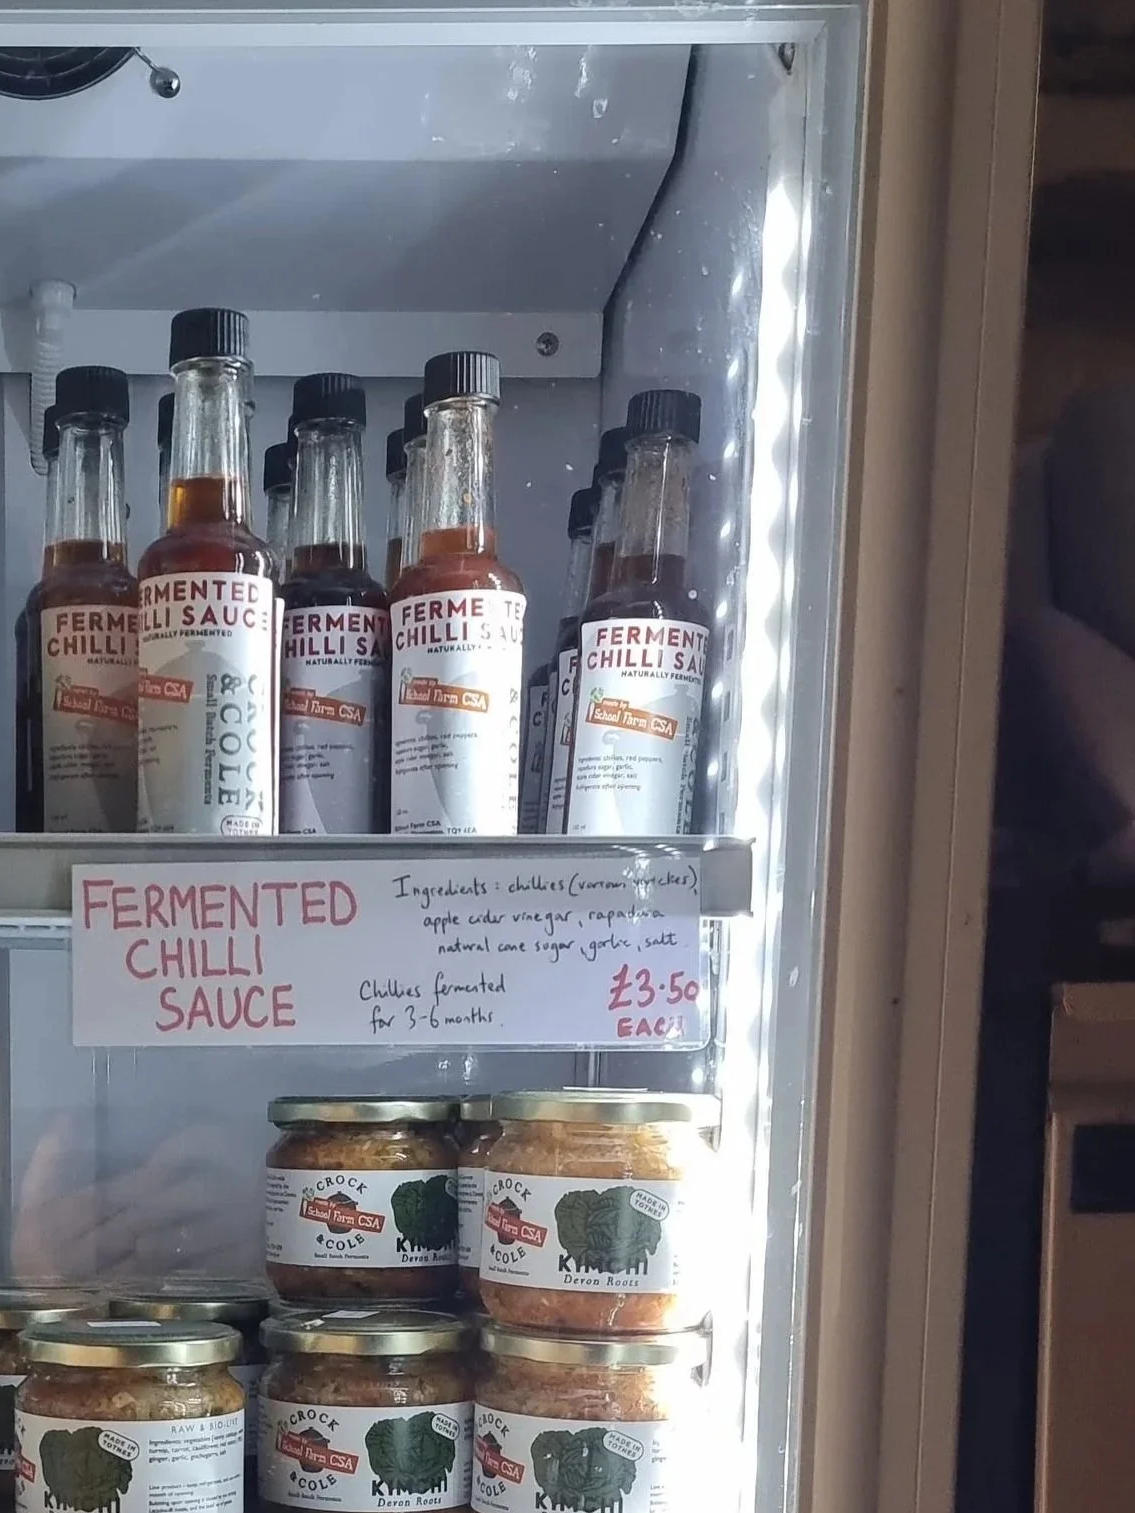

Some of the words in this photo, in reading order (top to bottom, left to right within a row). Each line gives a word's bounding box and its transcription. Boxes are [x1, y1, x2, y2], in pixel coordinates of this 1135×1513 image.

[396, 622, 467, 651] CHILLI
[587, 649, 663, 670] CHILLI
[621, 670, 669, 680] NATURALLY
[462, 693, 487, 711] CSA
[594, 710, 619, 722] School
[623, 712, 647, 728] Farm
[650, 715, 673, 736] CSA
[218, 703, 242, 805] COLE
[508, 877, 565, 892] chillies
[82, 879, 358, 930] FERMENTED
[423, 913, 460, 935] apple
[468, 911, 506, 926] cider
[125, 934, 264, 980] CHILLI
[438, 937, 491, 955] natural
[497, 941, 527, 954] cane
[360, 979, 422, 1001] Chillies
[434, 971, 507, 1006] fermented
[155, 984, 296, 1032] SAUCE
[370, 1006, 395, 1034] for
[316, 1175, 368, 1195] CROCK
[492, 1178, 532, 1202] CROCK
[635, 1192, 655, 1206] MADE
[307, 1206, 331, 1220] School
[333, 1211, 355, 1225] Farm
[357, 1216, 380, 1229] CSA
[402, 1254, 429, 1263] Devon
[564, 1275, 600, 1286] Devon
[606, 1277, 639, 1287] Roots
[171, 1424, 195, 1434] RAW
